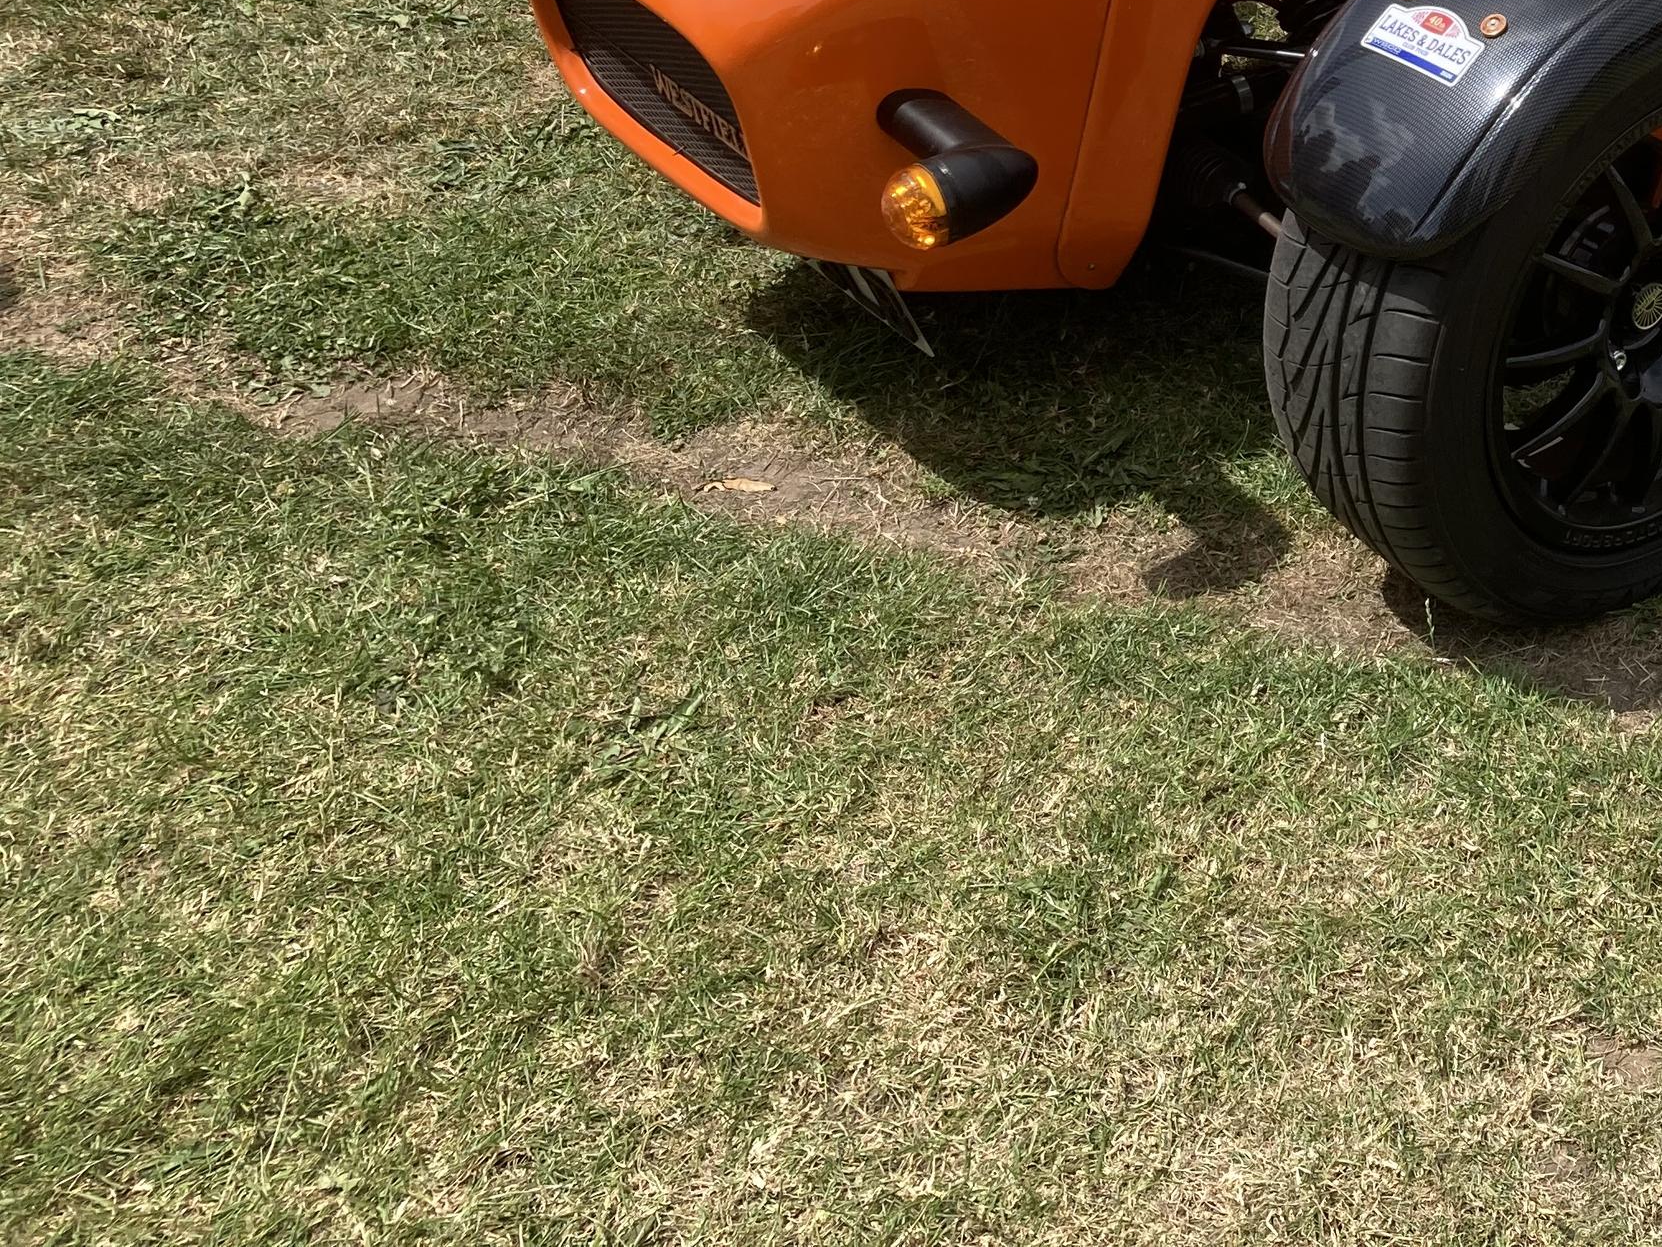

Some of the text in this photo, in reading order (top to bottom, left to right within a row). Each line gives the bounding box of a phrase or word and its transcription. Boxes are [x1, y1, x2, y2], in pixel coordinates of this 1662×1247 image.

[1378, 14, 1420, 42] LAKES
[1417, 34, 1428, 47] &
[1426, 38, 1471, 65] DALES
